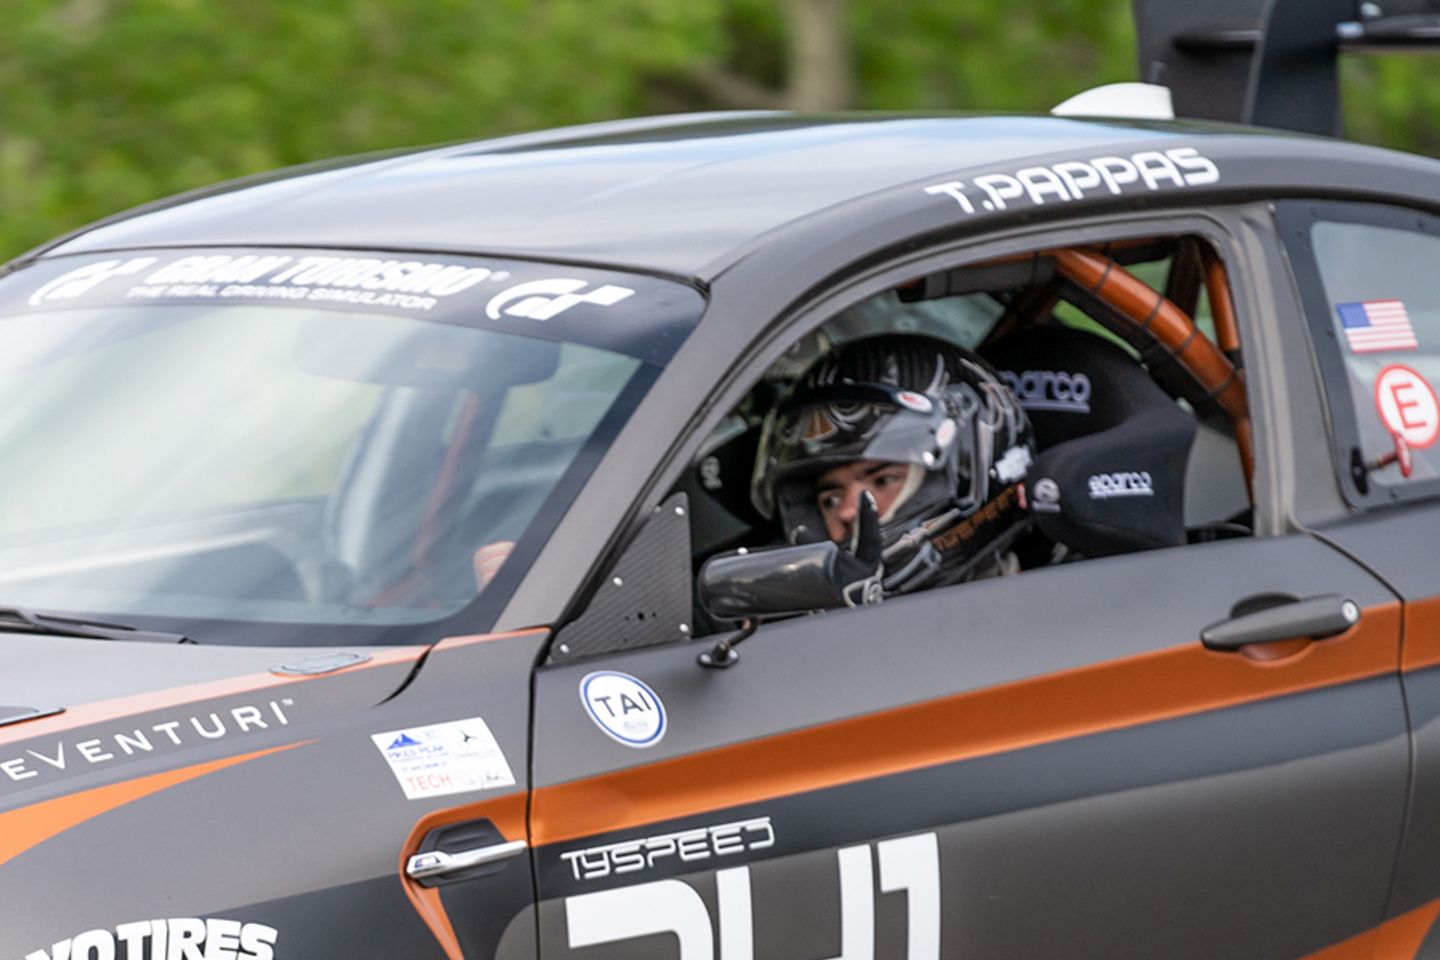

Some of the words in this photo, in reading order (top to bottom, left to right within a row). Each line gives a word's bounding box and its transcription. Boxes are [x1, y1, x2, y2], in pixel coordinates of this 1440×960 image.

[924, 147, 1220, 214] T.PAPPAS
[144, 256, 293, 284] GRAN
[307, 288, 438, 310] SIMULATOR
[998, 370, 1091, 402] parco
[1389, 381, 1428, 429] E
[594, 690, 651, 718] TAI
